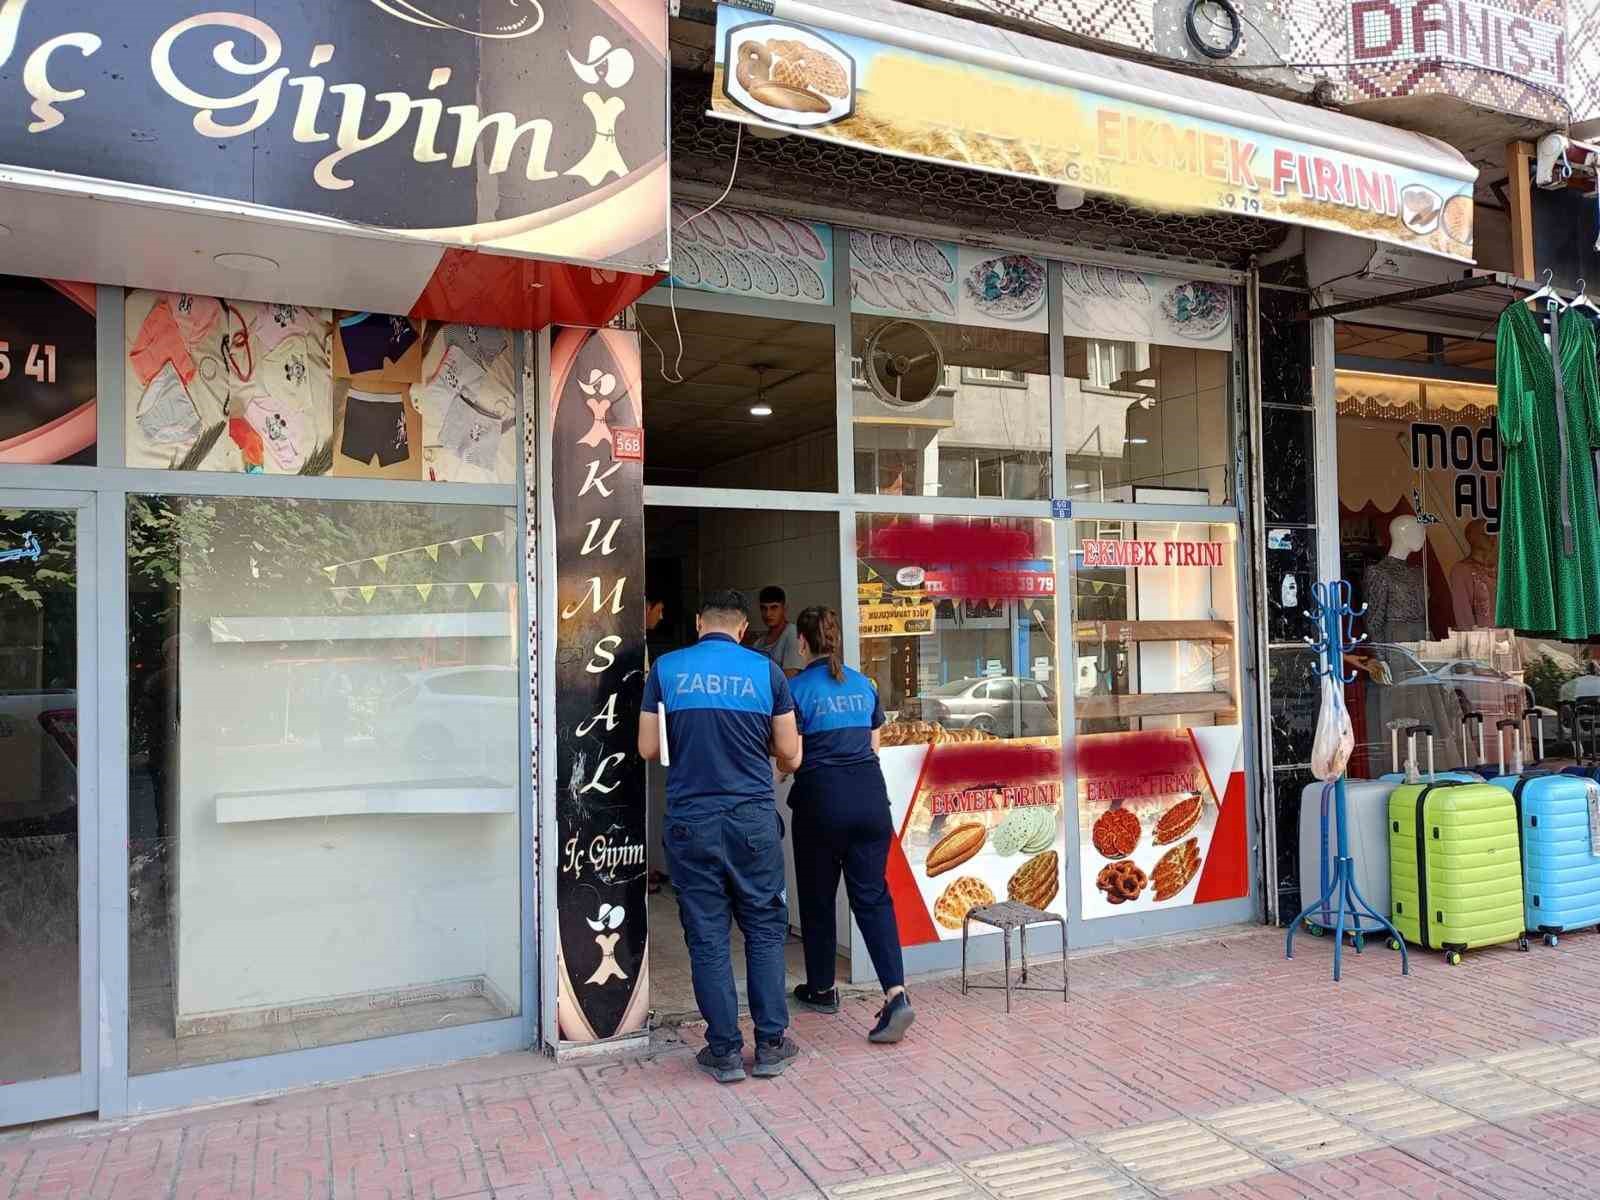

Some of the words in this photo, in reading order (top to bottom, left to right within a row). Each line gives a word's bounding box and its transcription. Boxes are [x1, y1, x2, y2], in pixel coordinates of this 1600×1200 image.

[150, 11, 557, 190] Giyim
[1096, 108, 1258, 194] EKMEK
[1271, 147, 1400, 217] FIRINI
[24, 343, 56, 383] 41
[616, 438, 641, 452] 568
[1411, 416, 1504, 472] mod
[1082, 540, 1158, 567] EKMEK
[1164, 541, 1224, 568] FIRINI
[1037, 577, 1055, 594] 79
[562, 459, 627, 794] KUMSAL
[931, 789, 996, 816] EKMEK
[1001, 783, 1057, 807] FIRINI
[589, 834, 645, 879] Giyim
